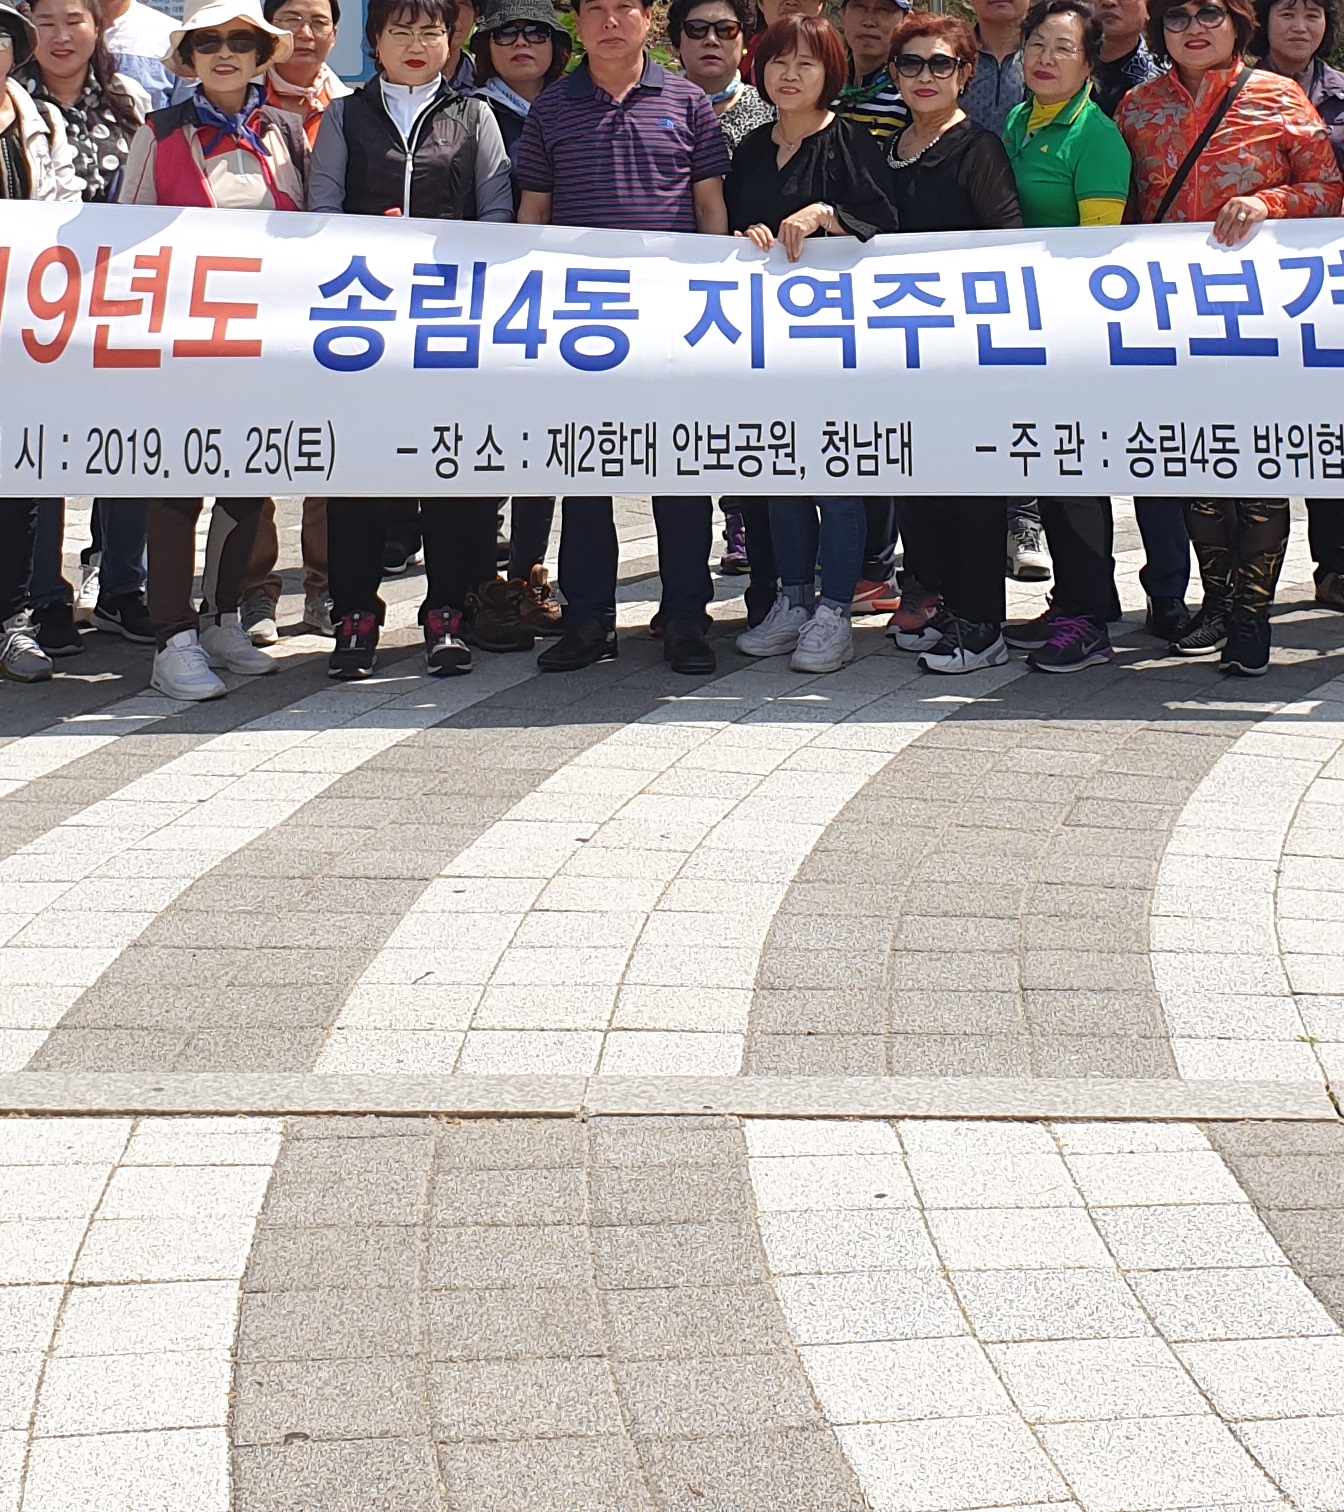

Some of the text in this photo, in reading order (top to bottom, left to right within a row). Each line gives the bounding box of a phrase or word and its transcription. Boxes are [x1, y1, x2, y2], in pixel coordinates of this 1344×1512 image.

[309, 255, 639, 371] 송림4동
[684, 266, 1047, 370] 지역주민
[85, 427, 170, 478] 2019.
[184, 427, 231, 478] 05.
[245, 419, 337, 481] 25(토)
[546, 420, 658, 479] 제2함대
[671, 420, 806, 481] 안보공원,
[820, 419, 914, 477] 청남대
[1125, 420, 1240, 479] 송림4동
